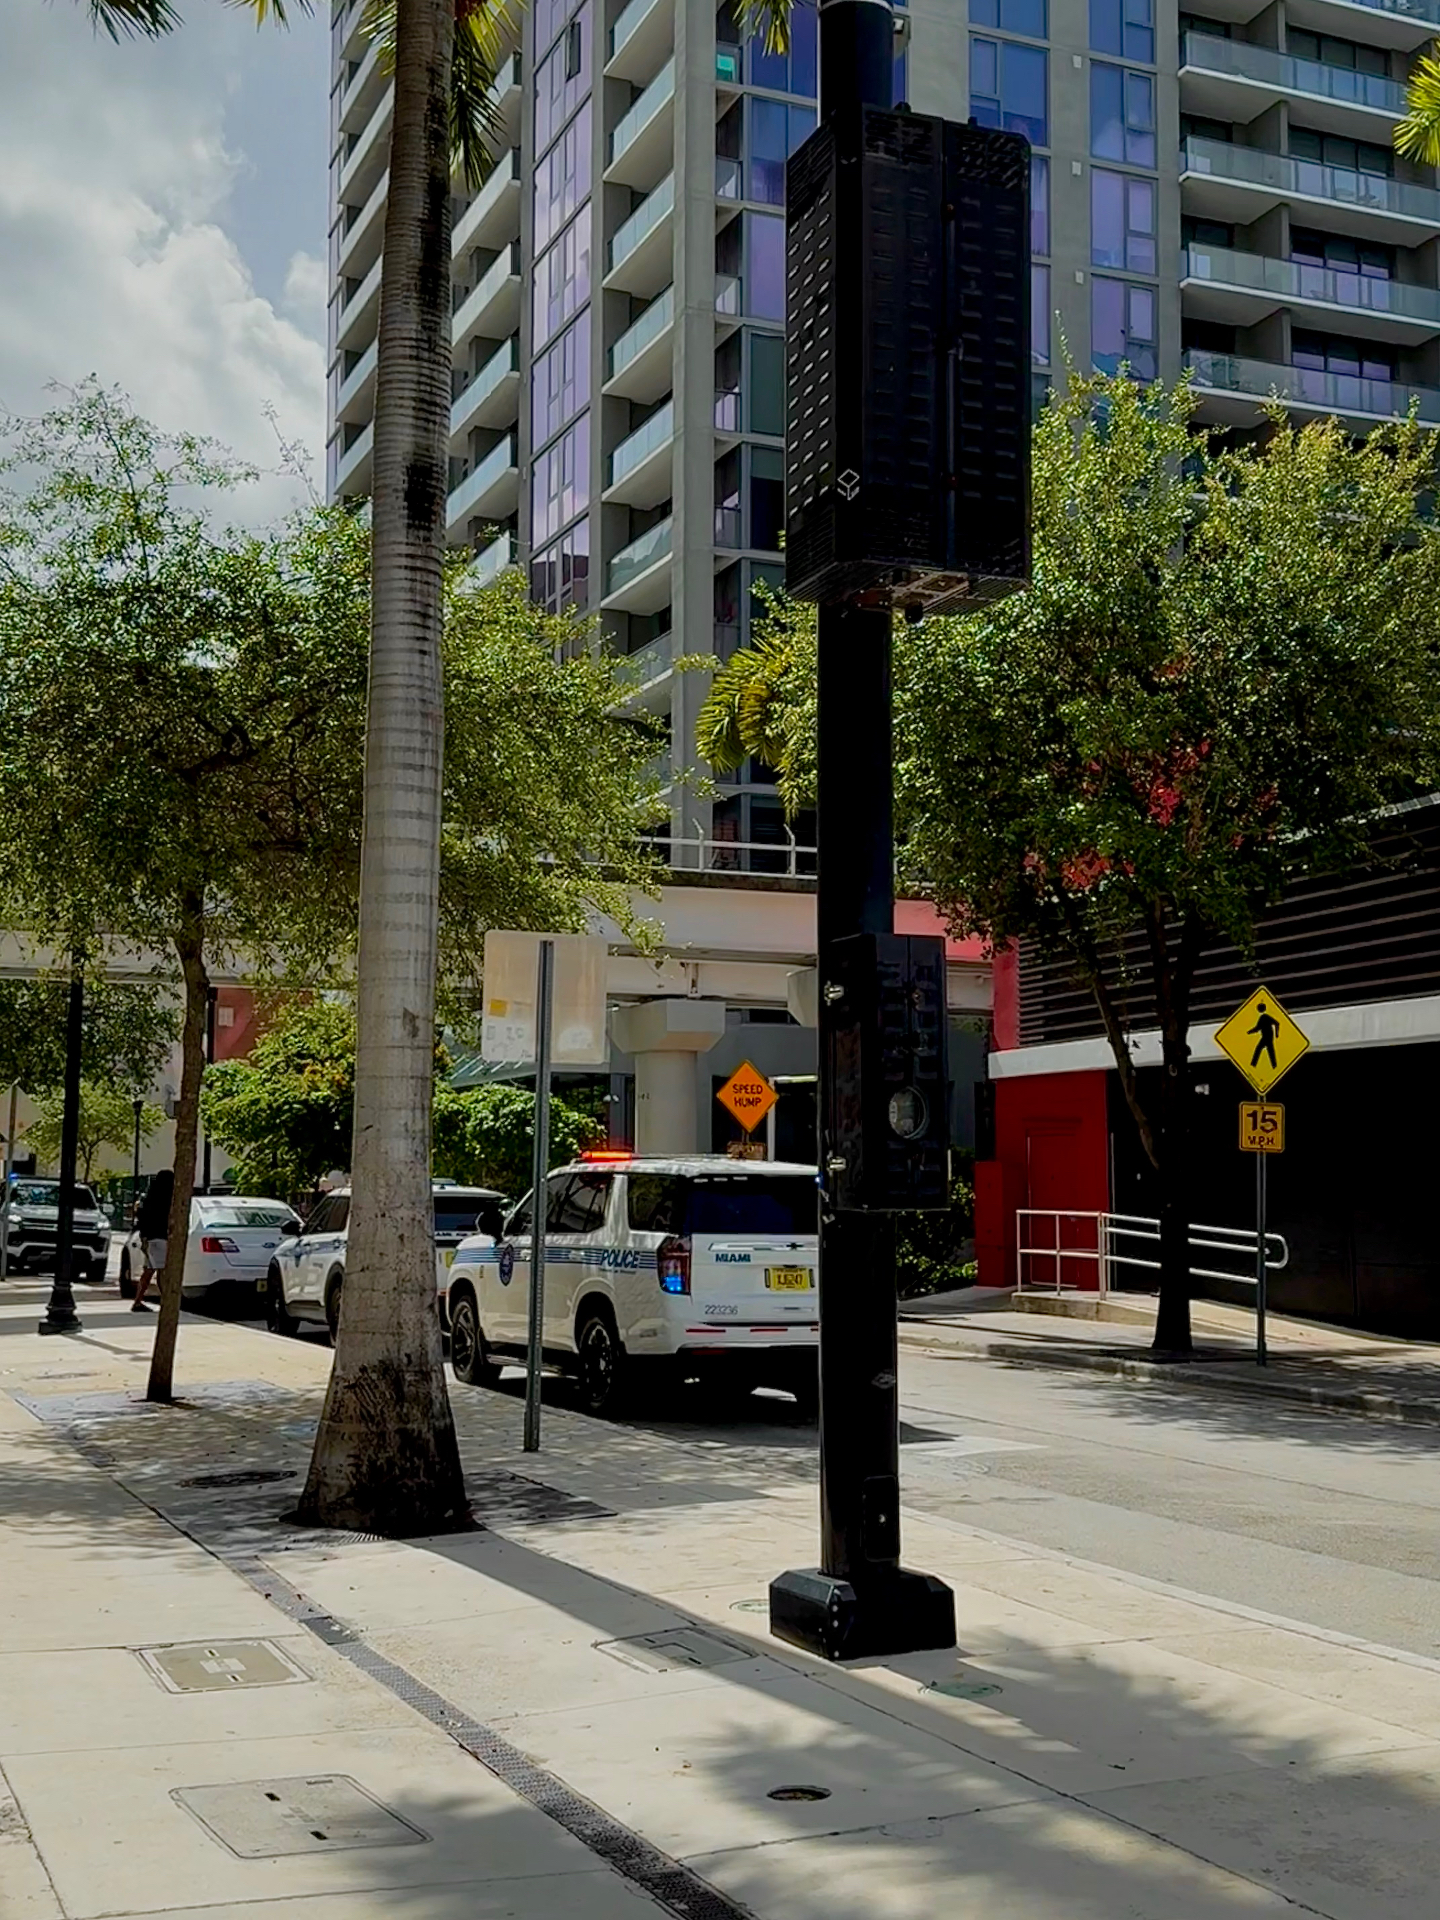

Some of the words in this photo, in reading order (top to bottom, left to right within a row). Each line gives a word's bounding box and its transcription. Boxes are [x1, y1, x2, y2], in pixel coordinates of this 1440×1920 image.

[732, 1083, 763, 1095] SPEED
[733, 1096, 762, 1108] HUMP
[1246, 1109, 1278, 1134] 15
[600, 1248, 640, 1268] POLICE
[715, 1253, 751, 1263] MIAMI
